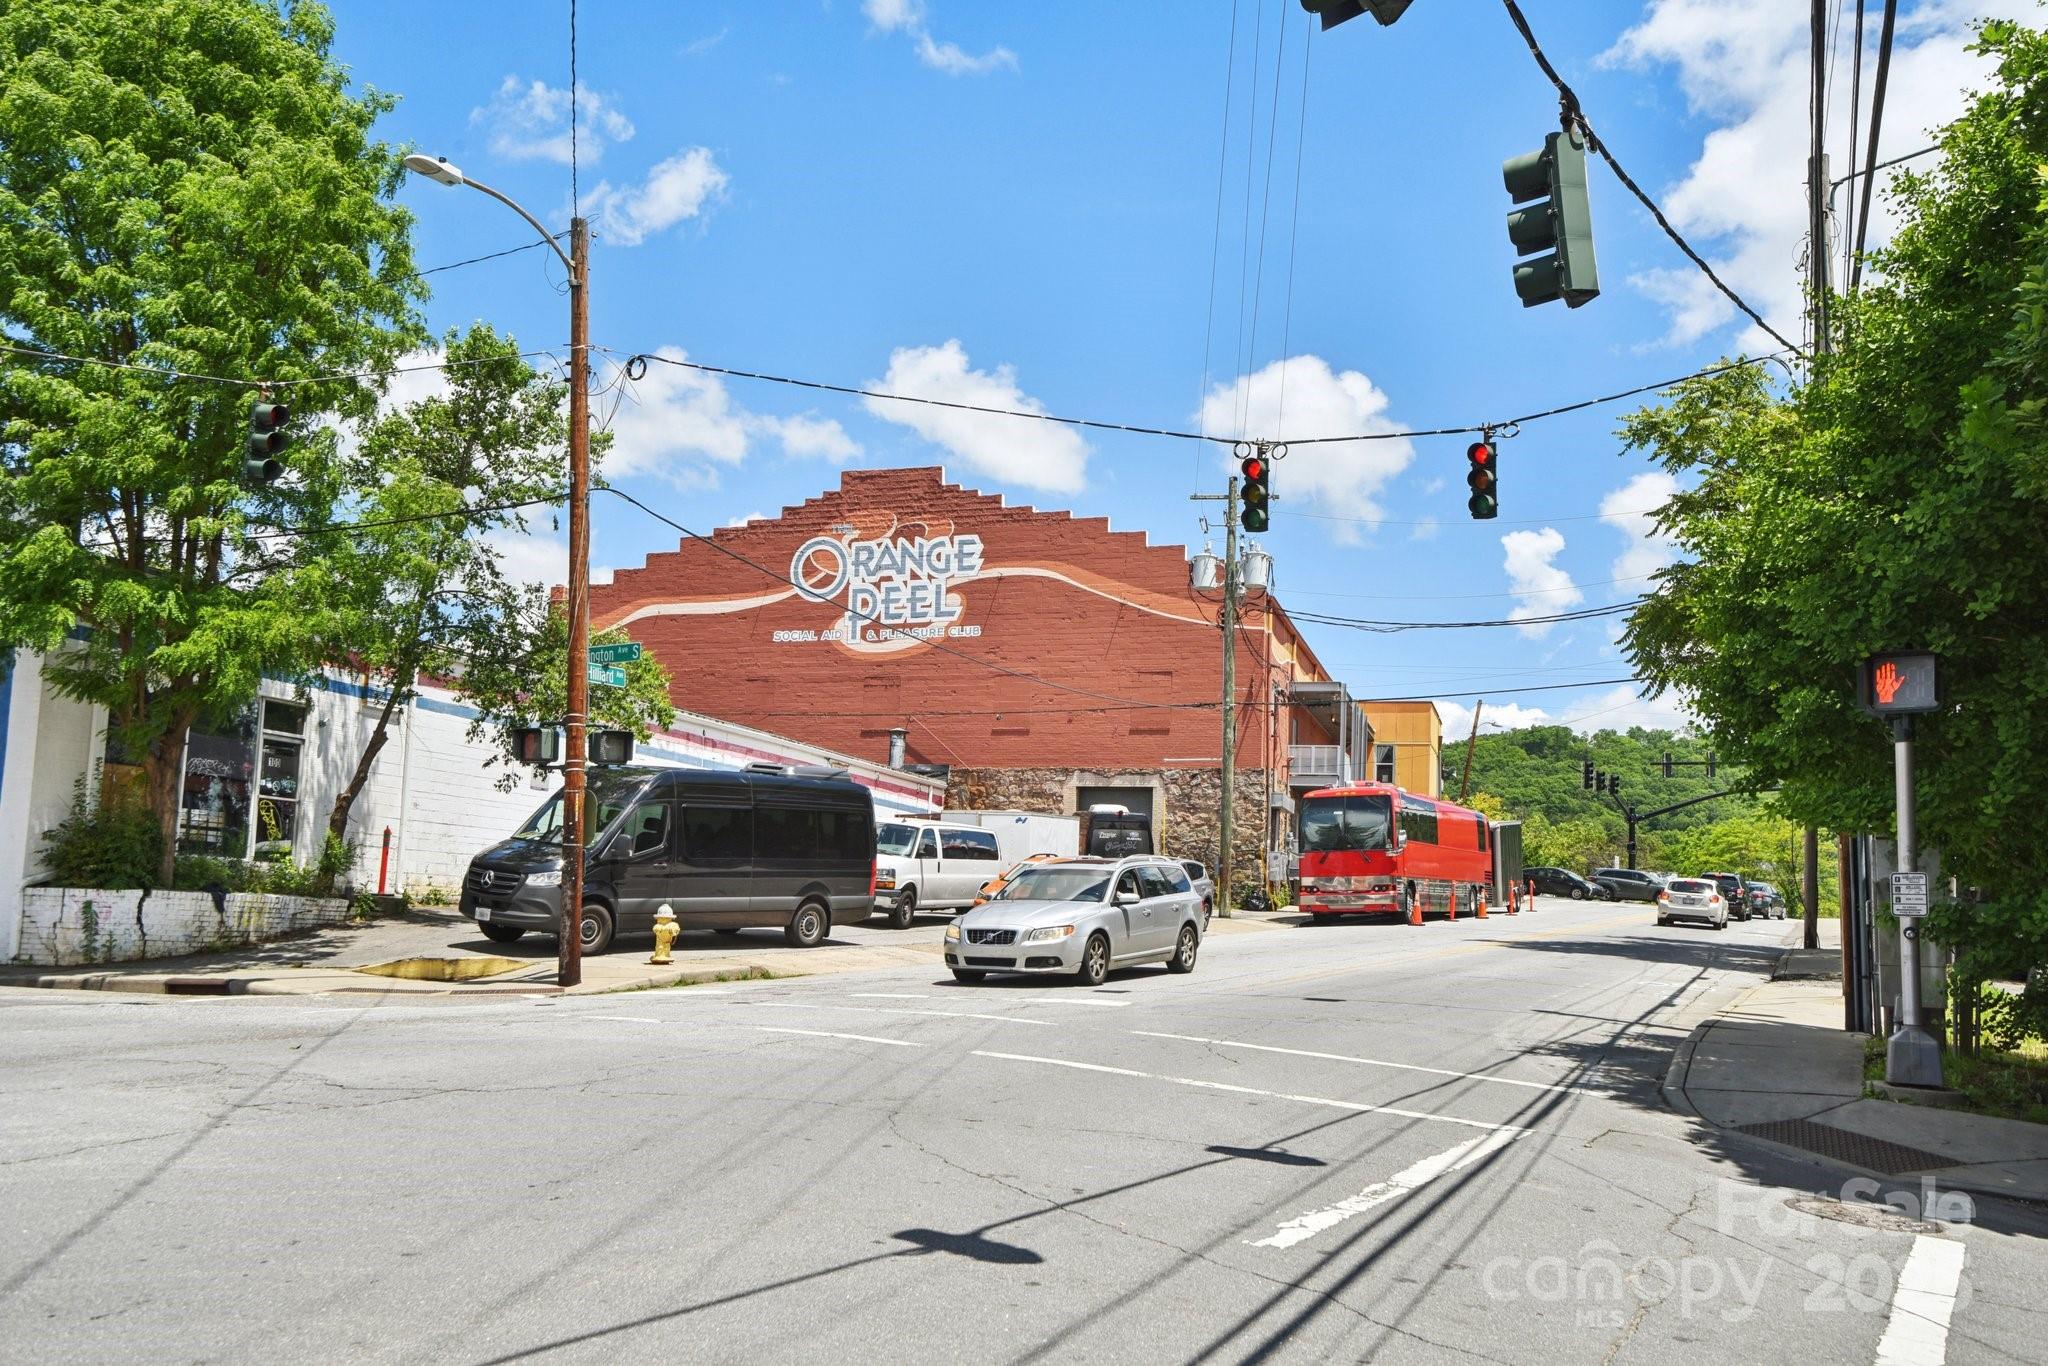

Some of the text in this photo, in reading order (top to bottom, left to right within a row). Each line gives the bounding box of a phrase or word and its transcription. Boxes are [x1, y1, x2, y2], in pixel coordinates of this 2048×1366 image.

[790, 534, 984, 603] ORANGE
[845, 579, 963, 643] PEEL
[589, 644, 639, 663] ngton Ave S
[773, 625, 982, 642] SOCIAL AID & PLEASURE CLUB
